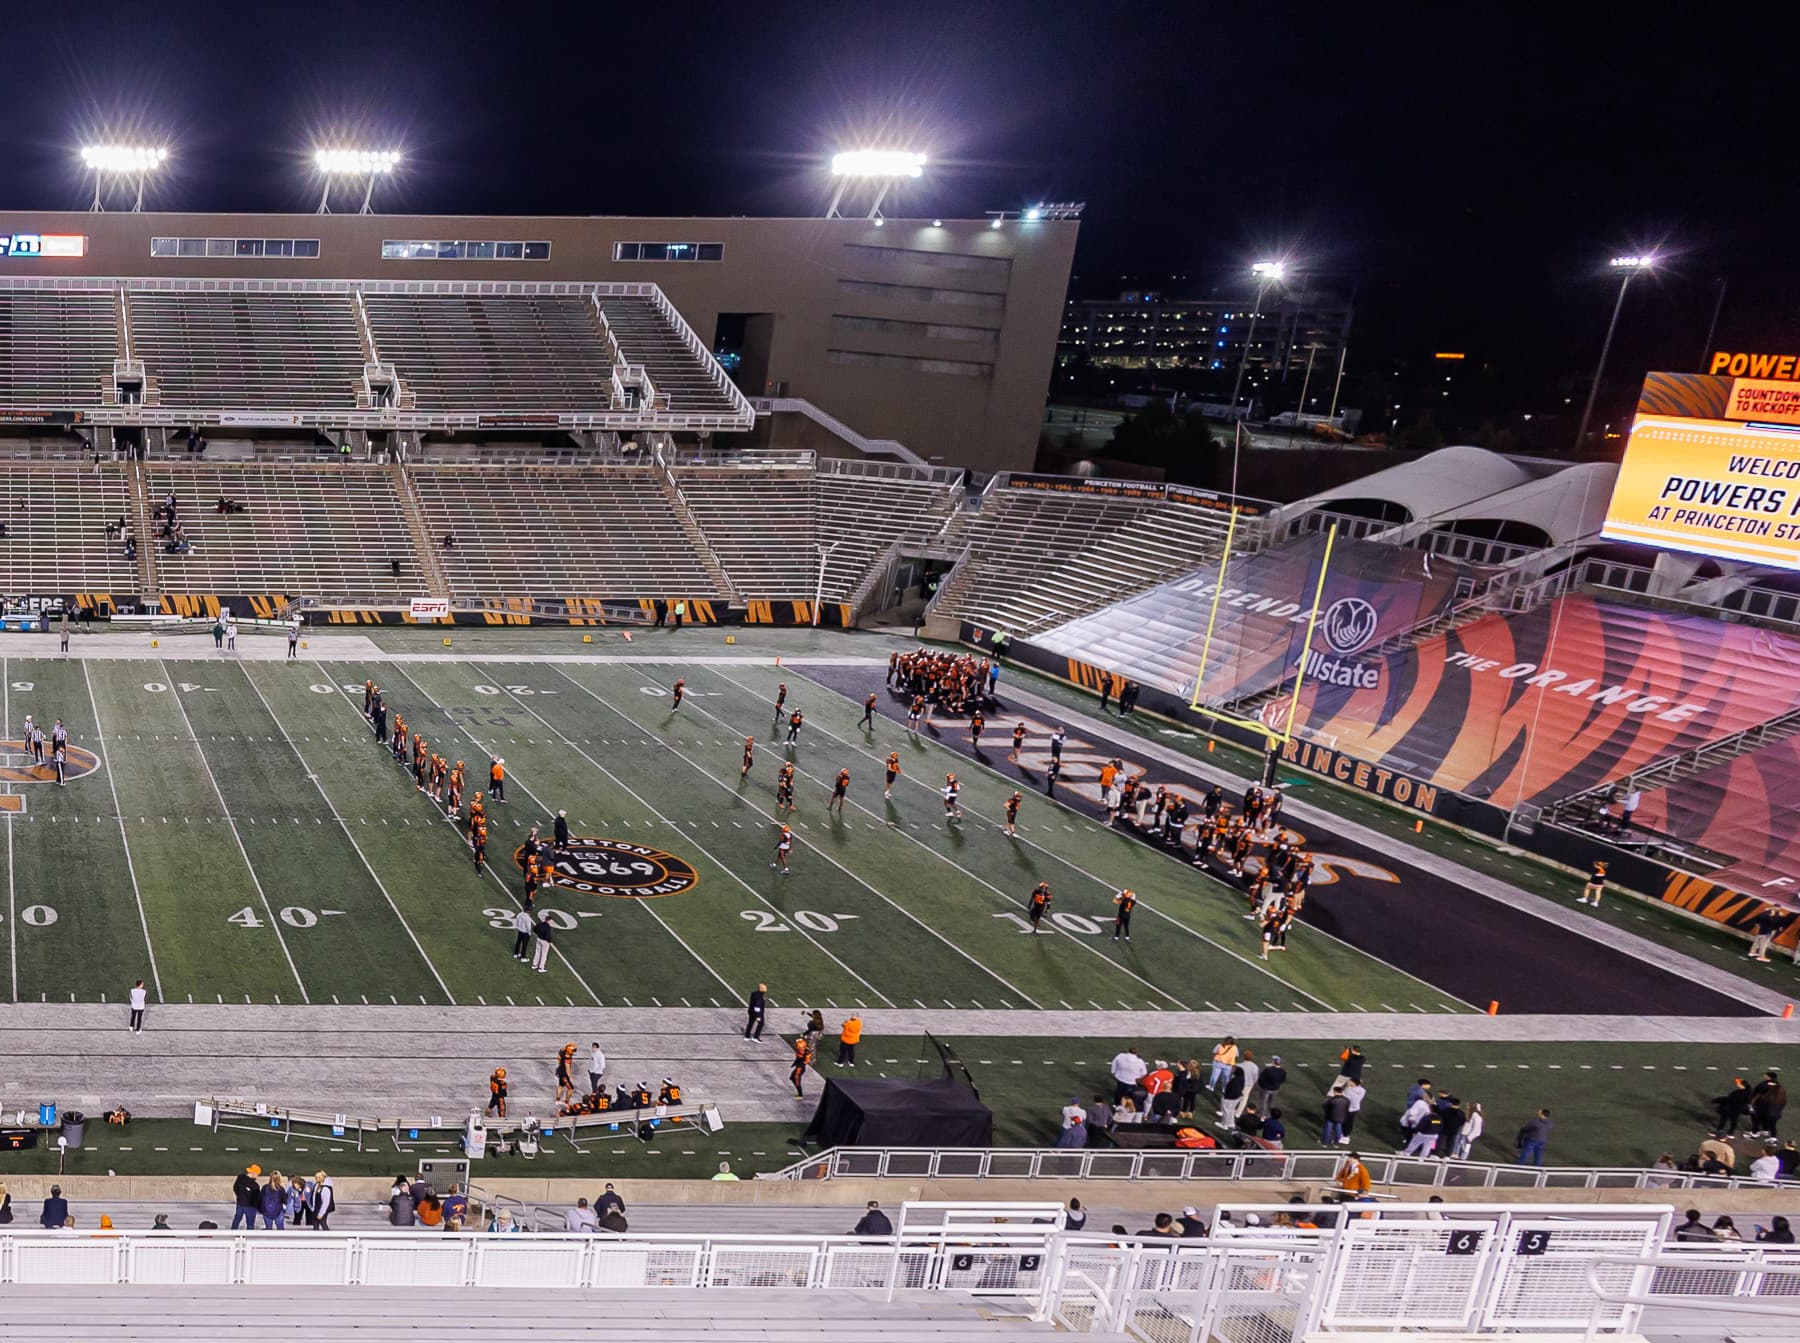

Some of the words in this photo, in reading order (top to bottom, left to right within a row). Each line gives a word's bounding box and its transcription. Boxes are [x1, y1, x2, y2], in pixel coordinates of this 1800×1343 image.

[1735, 400, 1750, 412] TO
[1751, 401, 1800, 415] KICKOFF
[1661, 477, 1786, 513] POWERS
[1648, 506, 1672, 521] AT
[1673, 509, 1772, 536] PRINCETON
[413, 603, 447, 612] ESPN
[1174, 579, 1324, 629] DEFENDE
[1443, 651, 1499, 673] THE
[1499, 662, 1707, 723] ORANGE
[1266, 737, 1437, 812] RINCETON
[575, 851, 617, 862] EST.
[555, 861, 655, 876] 1869
[556, 876, 689, 897] FOOTBALL
[226, 906, 319, 929] 40
[481, 908, 579, 930] 30
[740, 910, 841, 934] 20
[992, 912, 1103, 935] 10
[641, 1092, 648, 1104] 5
[1457, 1234, 1470, 1250] 6
[1527, 1234, 1542, 1250] 5
[958, 1256, 967, 1267] 6
[1025, 1256, 1035, 1268] 5
